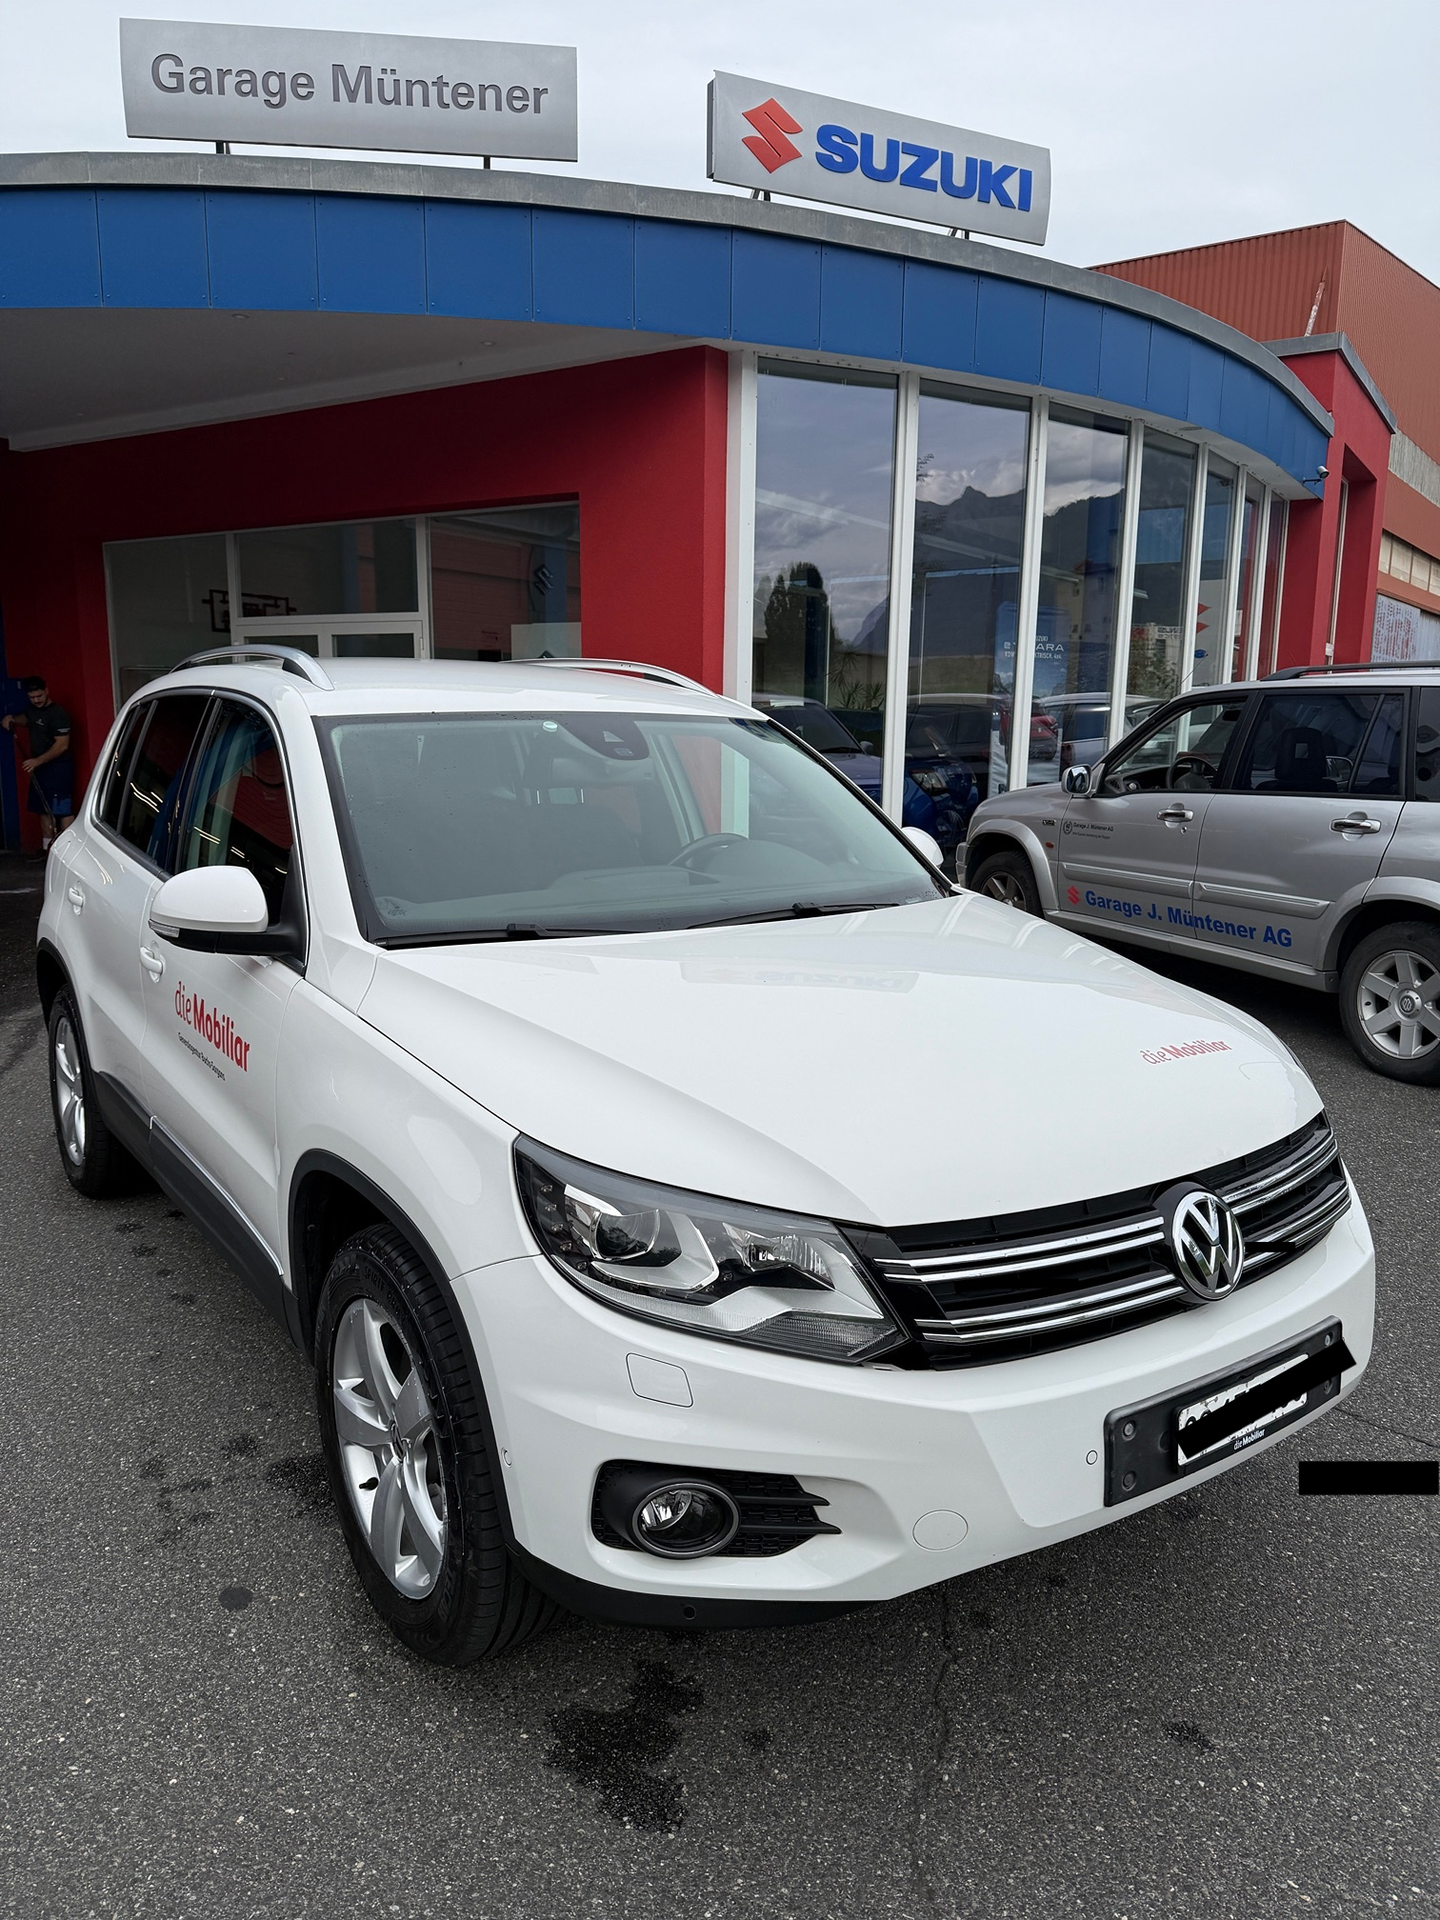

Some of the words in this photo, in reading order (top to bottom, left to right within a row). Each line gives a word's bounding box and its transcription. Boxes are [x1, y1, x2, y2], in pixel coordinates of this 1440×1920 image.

[150, 53, 315, 109] Garage
[331, 63, 548, 114] Müntener
[815, 124, 1032, 212] SUZUKI
[1085, 890, 1142, 918] Garage
[1147, 906, 1162, 921] J.
[1167, 906, 1257, 940] Müntener
[1262, 926, 1292, 948] AG
[175, 981, 192, 1025] die
[194, 993, 250, 1072] Mobiliar
[1140, 1050, 1171, 1065] die
[1160, 1040, 1232, 1059] Mobiliar
